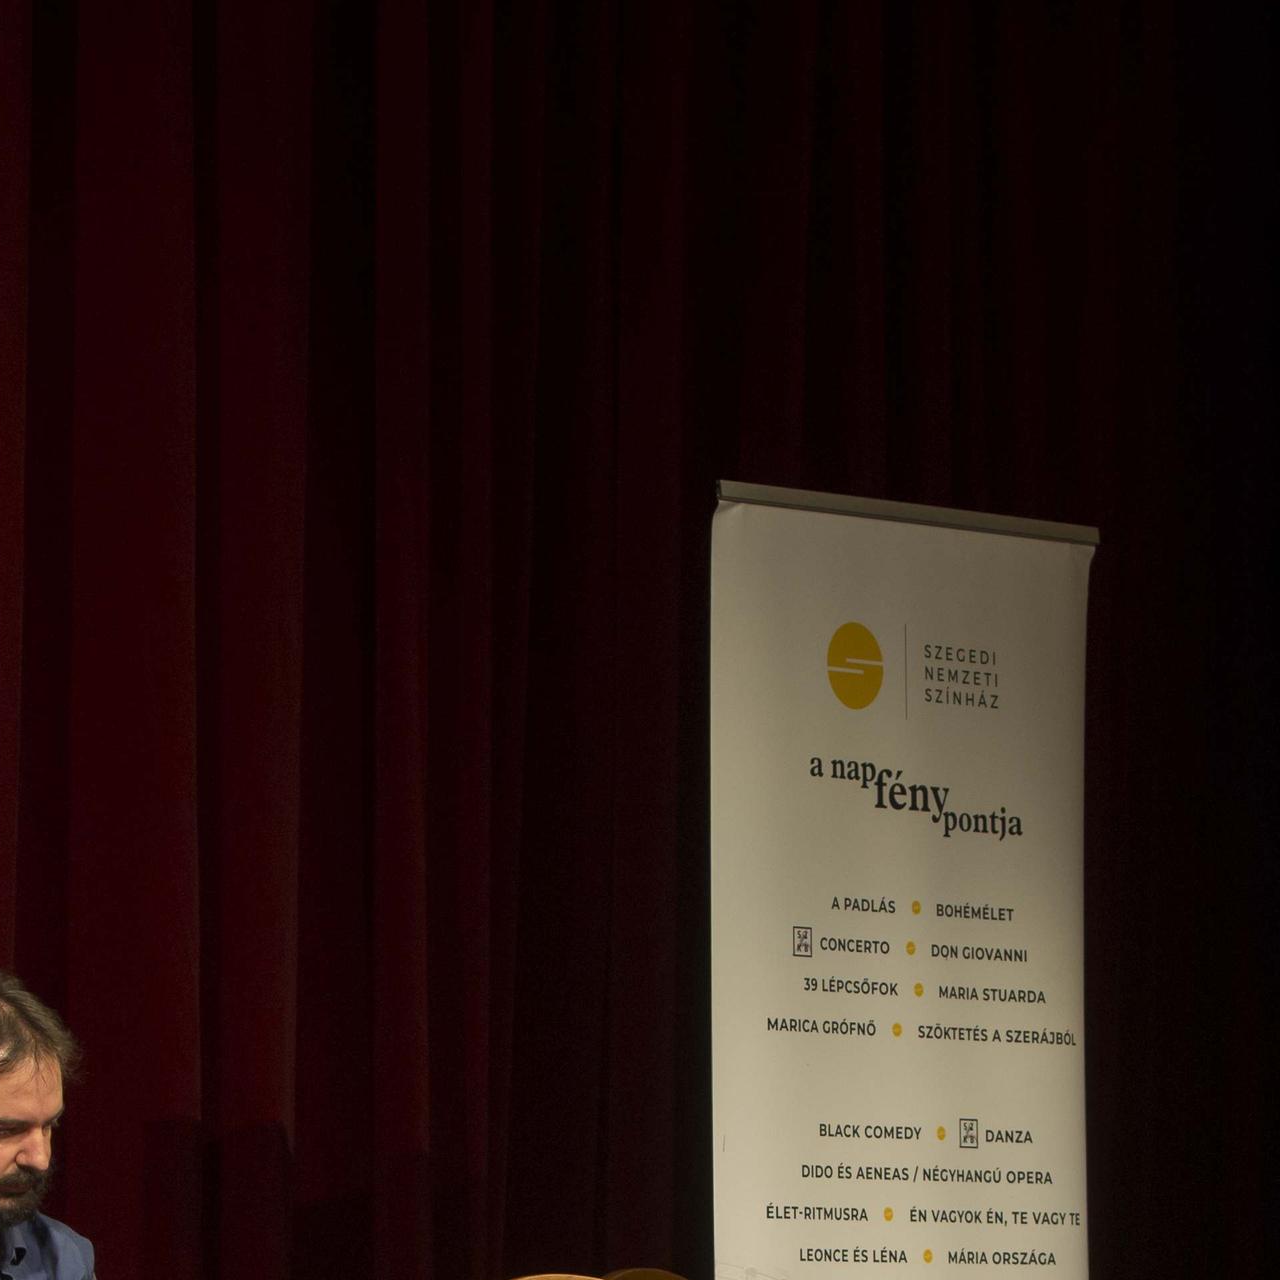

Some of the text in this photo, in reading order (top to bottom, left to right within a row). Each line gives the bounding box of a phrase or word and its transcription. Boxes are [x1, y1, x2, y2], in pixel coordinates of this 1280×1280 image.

[924, 643, 996, 666] SZEGEDI
[924, 665, 998, 688] NEMZETI
[924, 686, 999, 710] SZÍNHÁZ
[809, 756, 824, 778] a
[831, 896, 1015, 922] A PADLÁS BOHÉMÉLET
[819, 936, 1028, 963] CONCERTO DON GIOVANNI
[803, 975, 1047, 1004] 39 LÉPCSŐFOK MARIA STUARDA
[767, 1017, 1077, 1047] MARICA GRÓFNŐ SZÖKTETÉS A SZERÁJBÓL
[819, 1123, 1033, 1144] BLACK COMEDY DANZA
[801, 1164, 834, 1179] DIDO
[837, 1162, 853, 1180] ÉS
[855, 1166, 910, 1181] AENEAS
[922, 1164, 1002, 1184] NÉGYHANGÚ
[1006, 1170, 1053, 1185] OPERA
[766, 1202, 1081, 1227] ÉLET-RITMUSRA ÉN VAGYOK ÉN, TE VAGY TE
[799, 1246, 1057, 1266] LEONCE ÉS LÉNA MÁRIA ORSZÁGA
